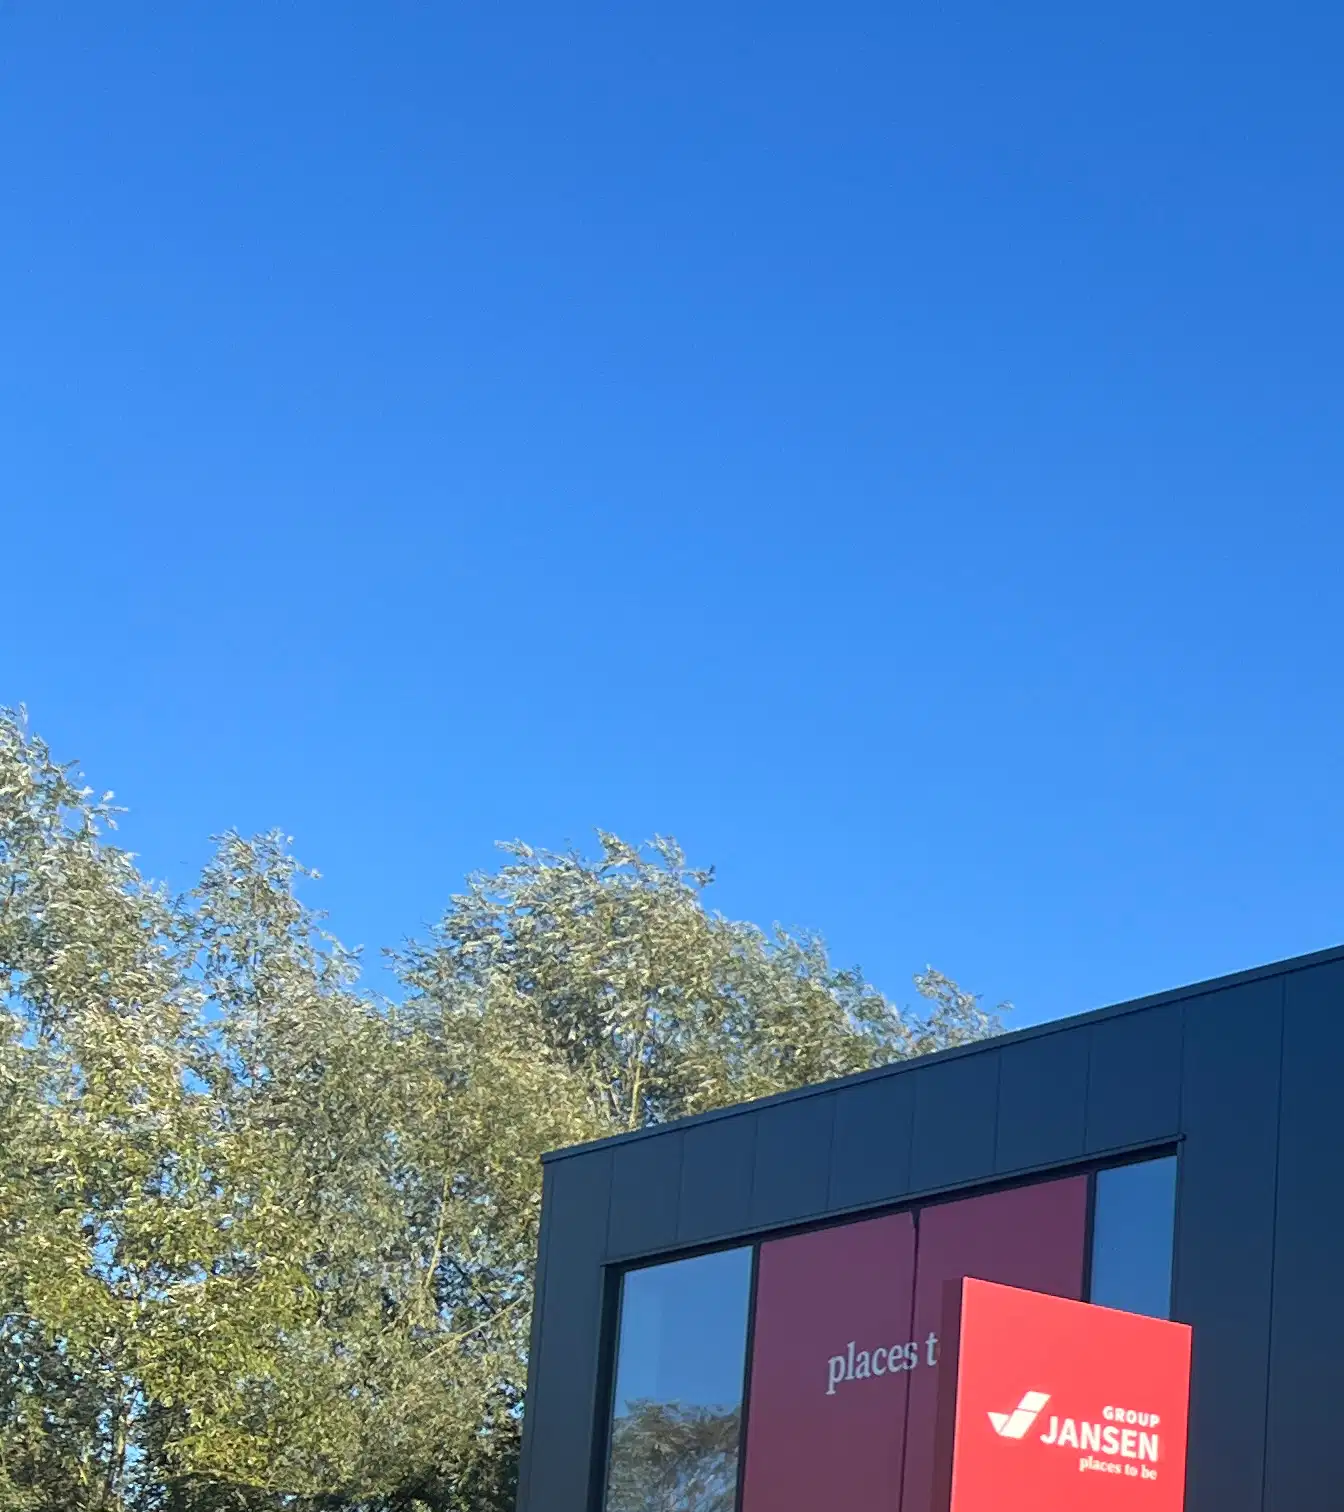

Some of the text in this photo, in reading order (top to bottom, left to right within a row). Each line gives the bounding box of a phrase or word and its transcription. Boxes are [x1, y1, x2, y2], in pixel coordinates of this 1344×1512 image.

[825, 1332, 939, 1395] places t
[1102, 1405, 1161, 1428] GROUP
[1040, 1415, 1159, 1462] JANSEN
[1079, 1455, 1157, 1480] places to be
